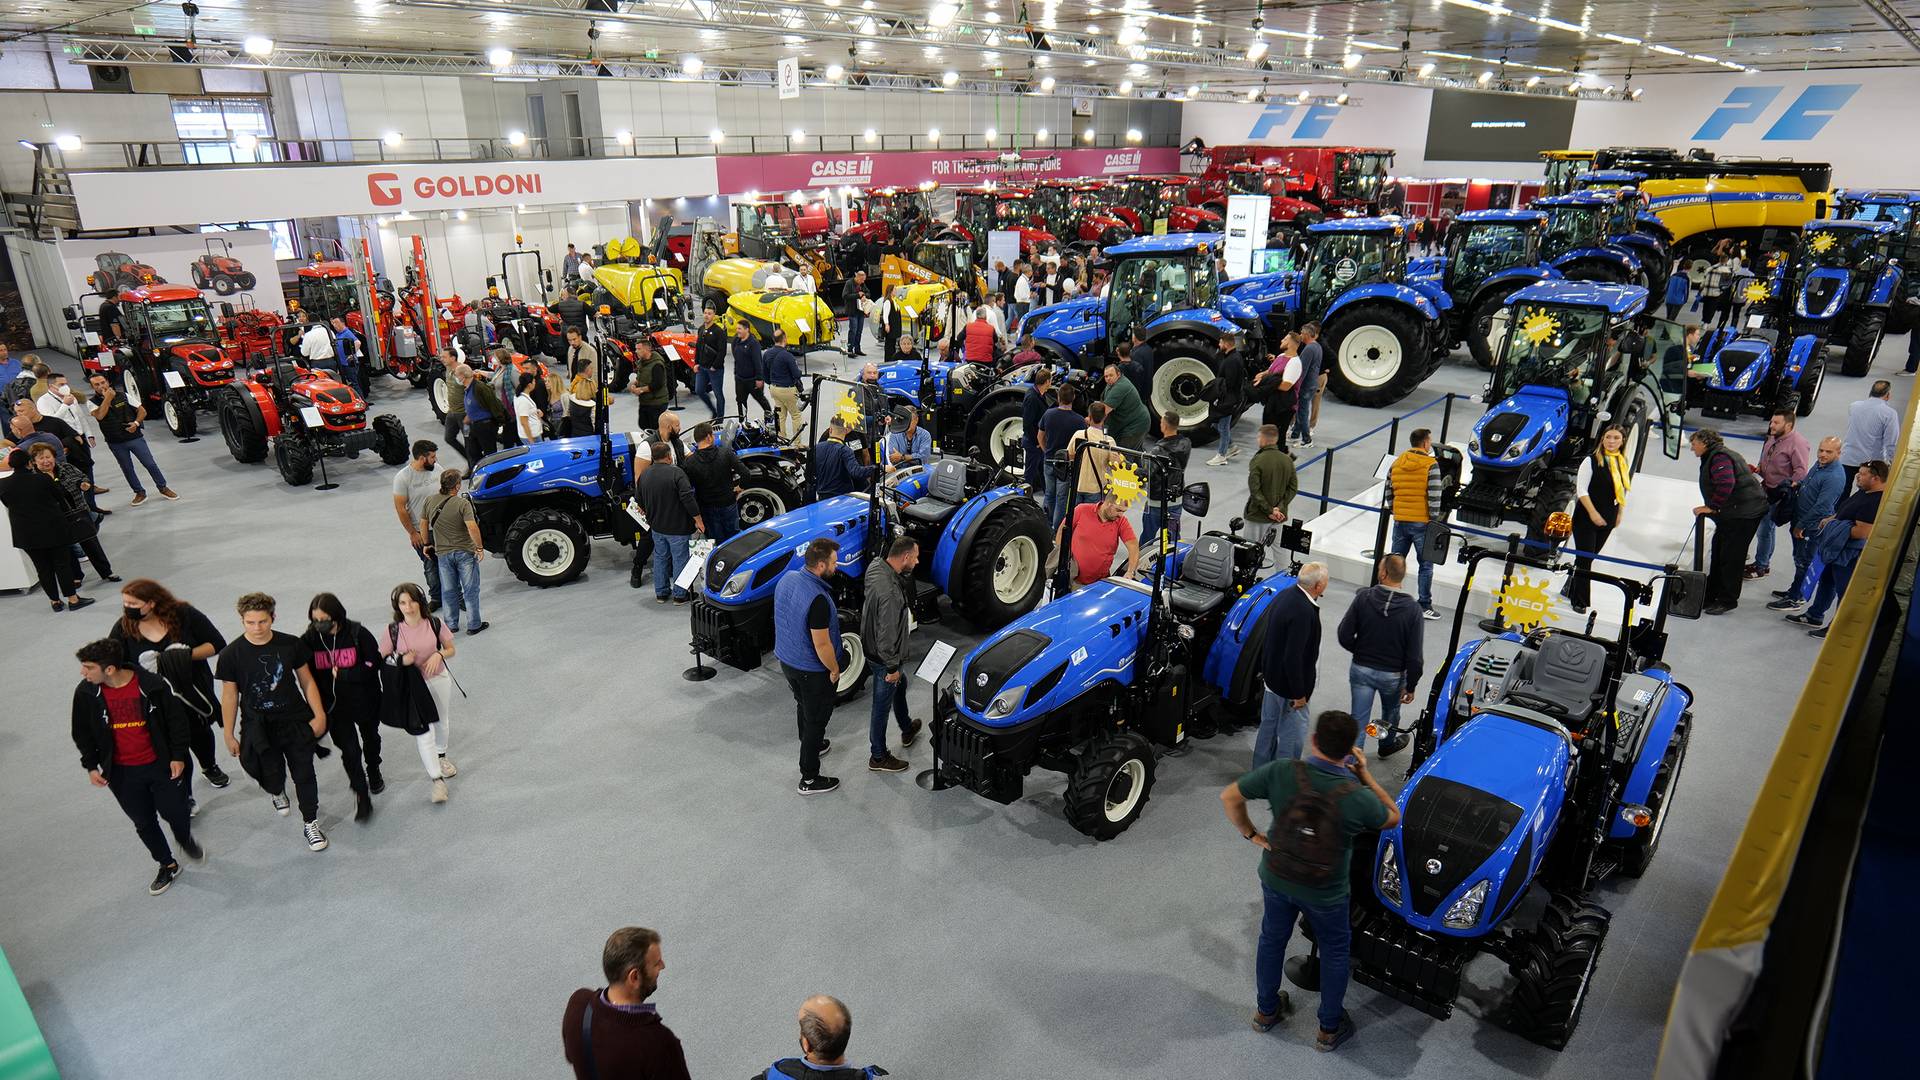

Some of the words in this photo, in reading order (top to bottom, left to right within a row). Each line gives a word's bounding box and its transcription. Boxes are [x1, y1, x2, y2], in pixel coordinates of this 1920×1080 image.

[932, 160, 949, 175] FOR
[1105, 154, 1132, 166] CASE
[811, 160, 857, 176] CASE
[414, 174, 542, 199] GOLDONI
[1649, 201, 1669, 210] NEW
[1669, 196, 1707, 206] HOLLAND
[908, 264, 932, 281] CASE
[840, 404, 858, 414] NEO
[1114, 478, 1137, 490] NEO
[1505, 594, 1544, 613] NEO
